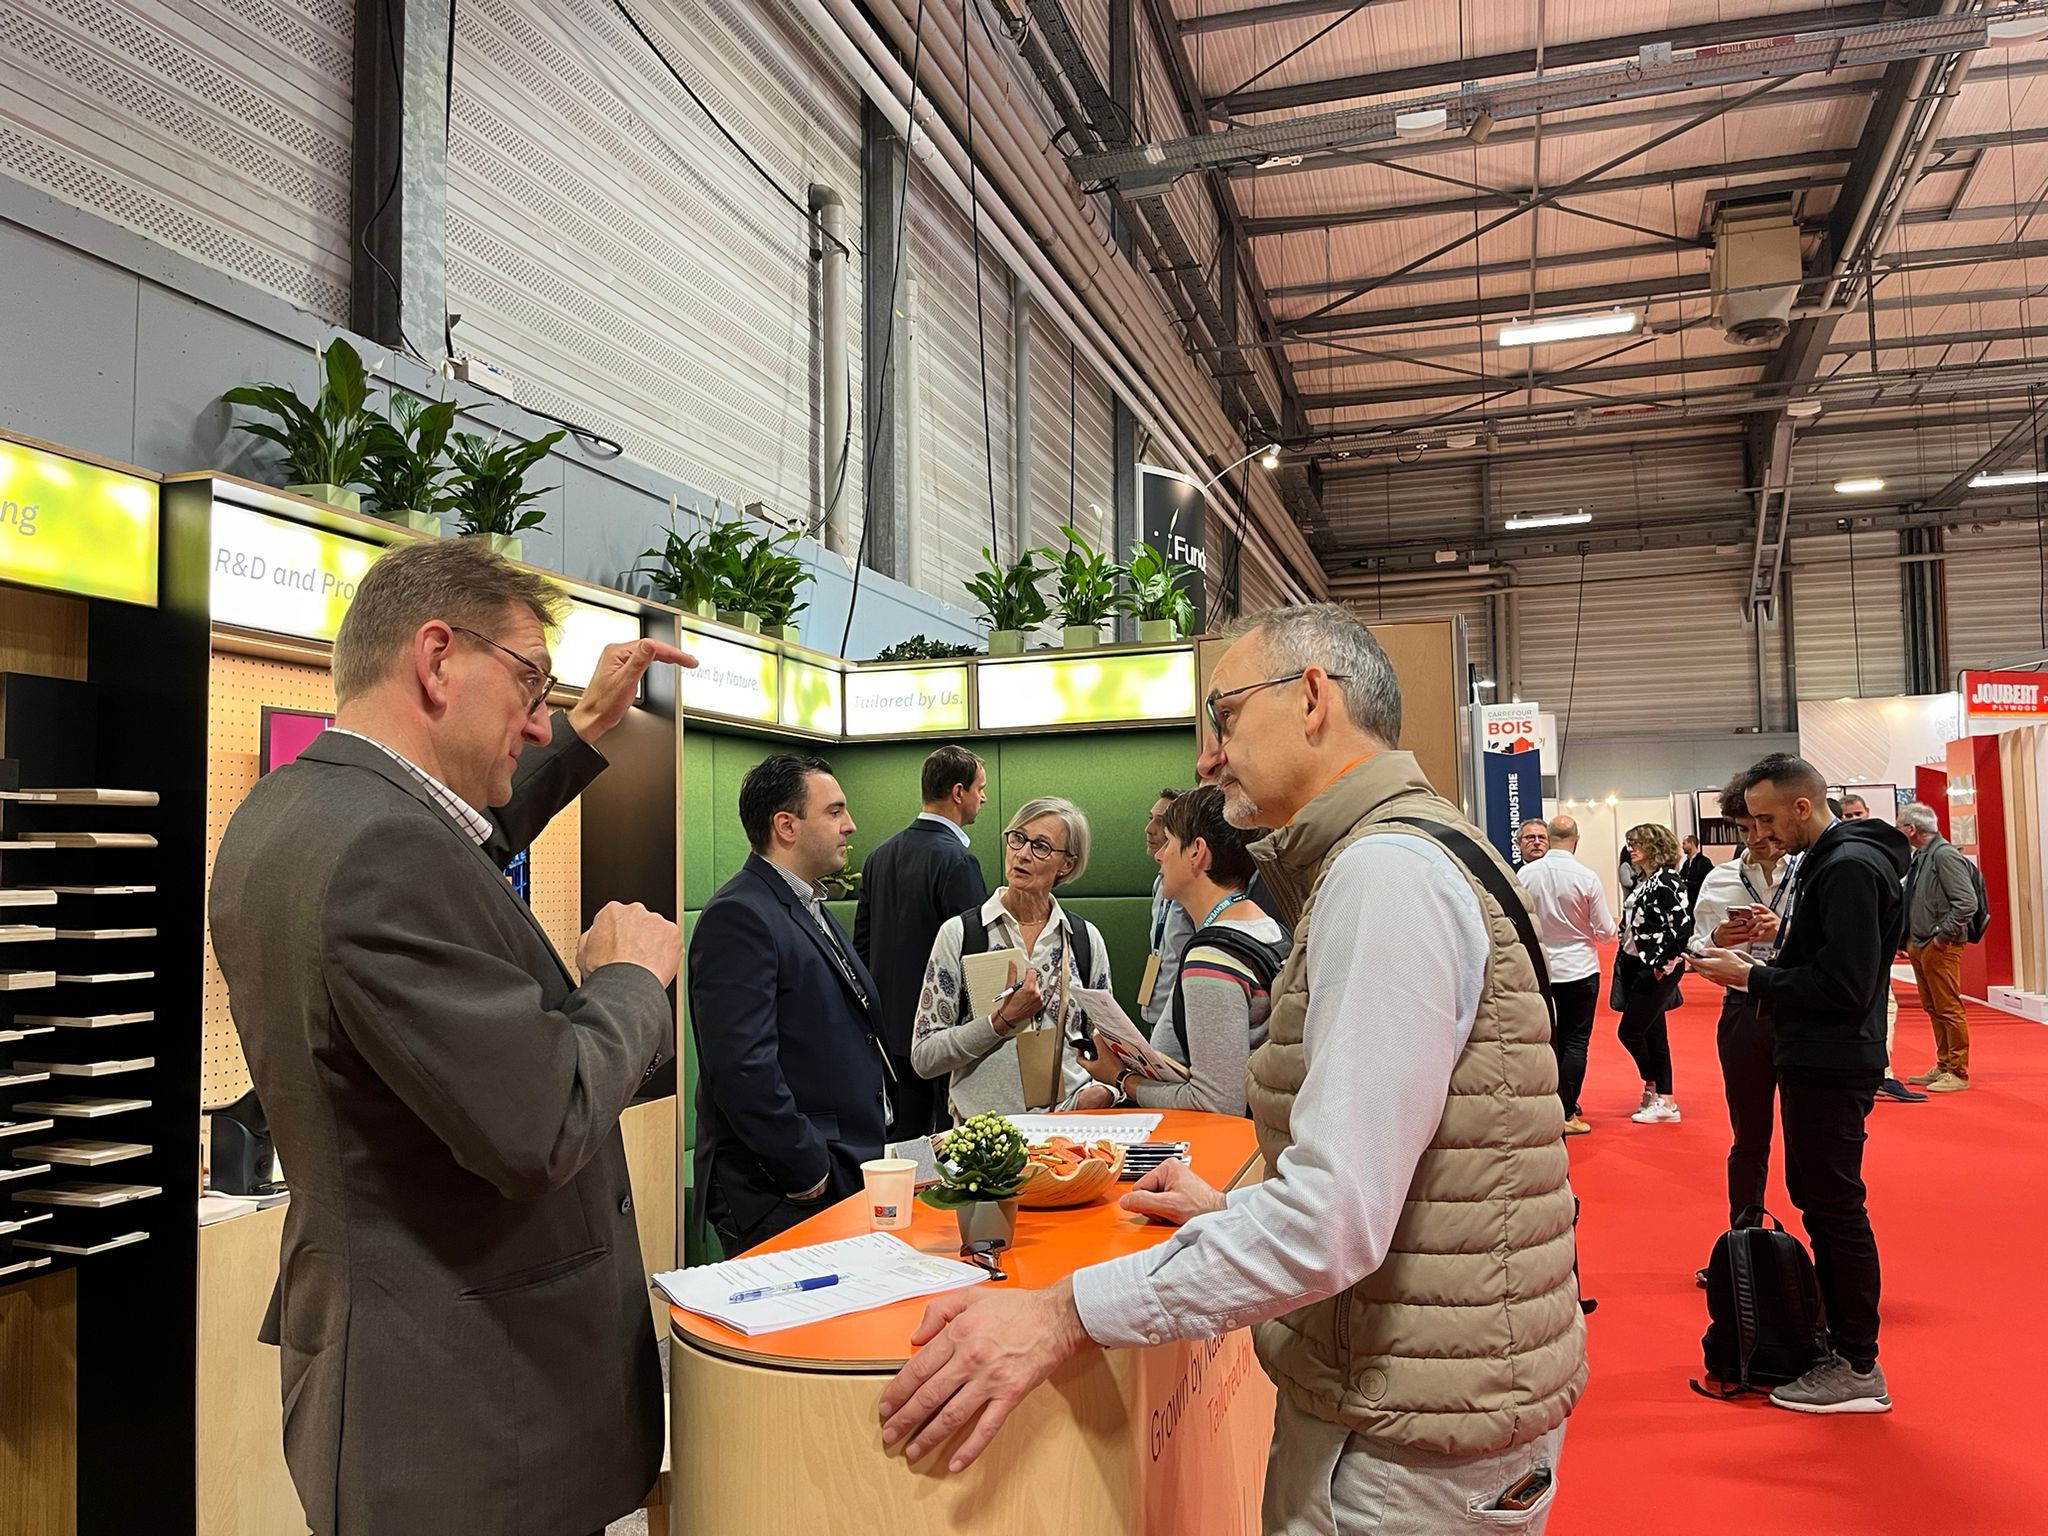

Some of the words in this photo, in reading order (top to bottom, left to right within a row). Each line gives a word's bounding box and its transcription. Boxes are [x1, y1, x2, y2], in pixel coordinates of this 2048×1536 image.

[0, 501, 39, 536] ng
[1174, 535, 1206, 574] Fund
[215, 548, 266, 580] R&D
[273, 566, 316, 592] and
[321, 572, 355, 600] Pro
[713, 667, 724, 687] by
[727, 670, 759, 691] Nature.
[1972, 683, 2039, 705] JOUBERT
[854, 693, 914, 709] Tailored
[918, 692, 936, 710] by
[940, 691, 963, 706] Us.
[1488, 720, 1532, 735] BOIS
[1508, 773, 1520, 829] INDUSTRIE
[1151, 1373, 1189, 1462] Grown
[1190, 1347, 1202, 1395] by
[1207, 1344, 1241, 1441] Tailored
[1241, 1337, 1251, 1378] by
